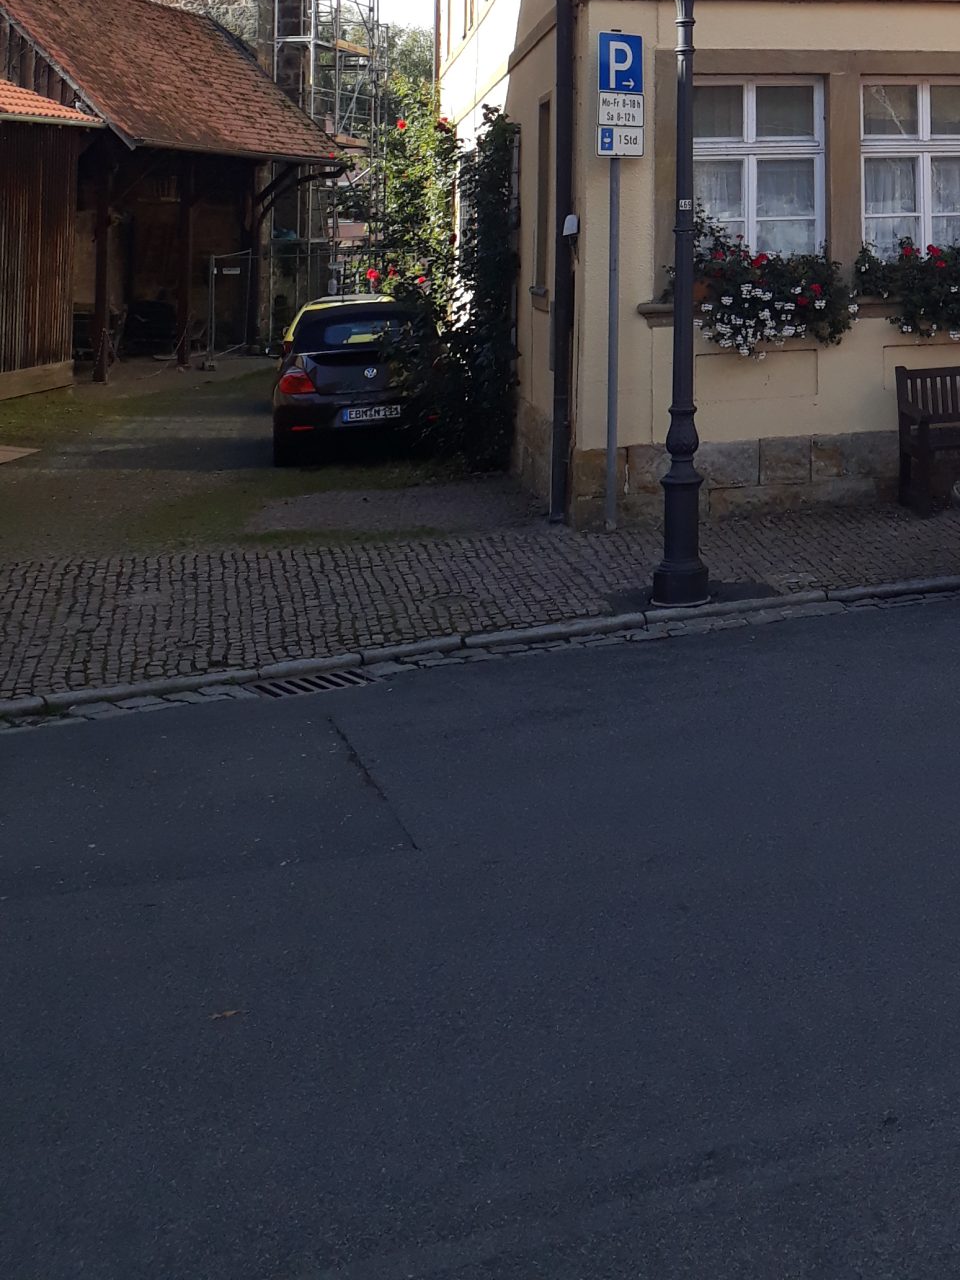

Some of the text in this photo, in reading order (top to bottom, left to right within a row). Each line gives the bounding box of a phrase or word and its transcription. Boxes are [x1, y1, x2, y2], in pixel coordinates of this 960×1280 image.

[609, 41, 633, 89] P
[602, 97, 619, 107] Mo-Fr
[606, 111, 614, 121] Sa
